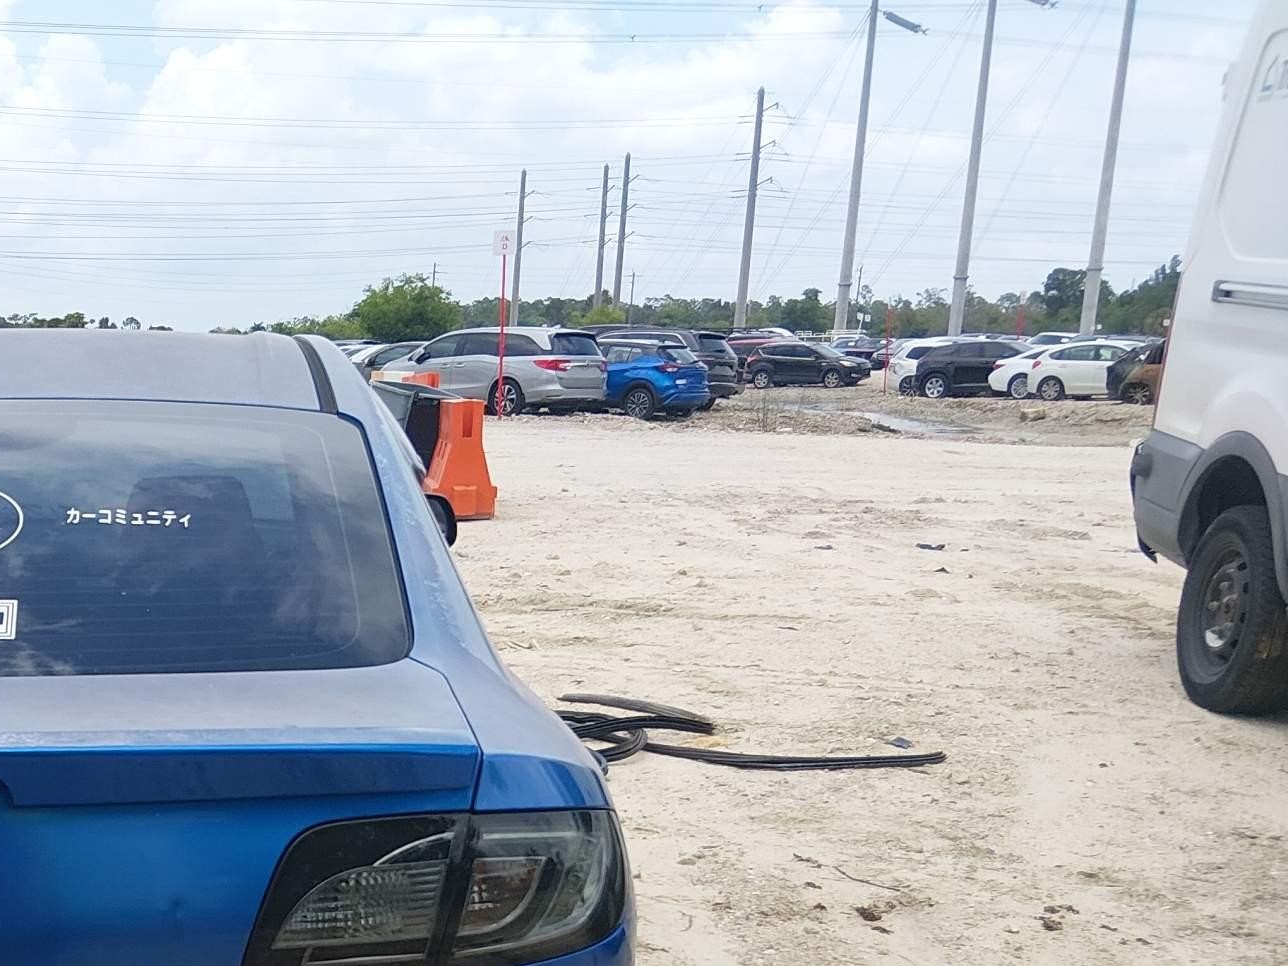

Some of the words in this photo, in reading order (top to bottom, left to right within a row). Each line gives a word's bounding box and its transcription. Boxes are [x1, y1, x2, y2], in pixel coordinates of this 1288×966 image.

[66, 507, 191, 528] カーコミュニティ
